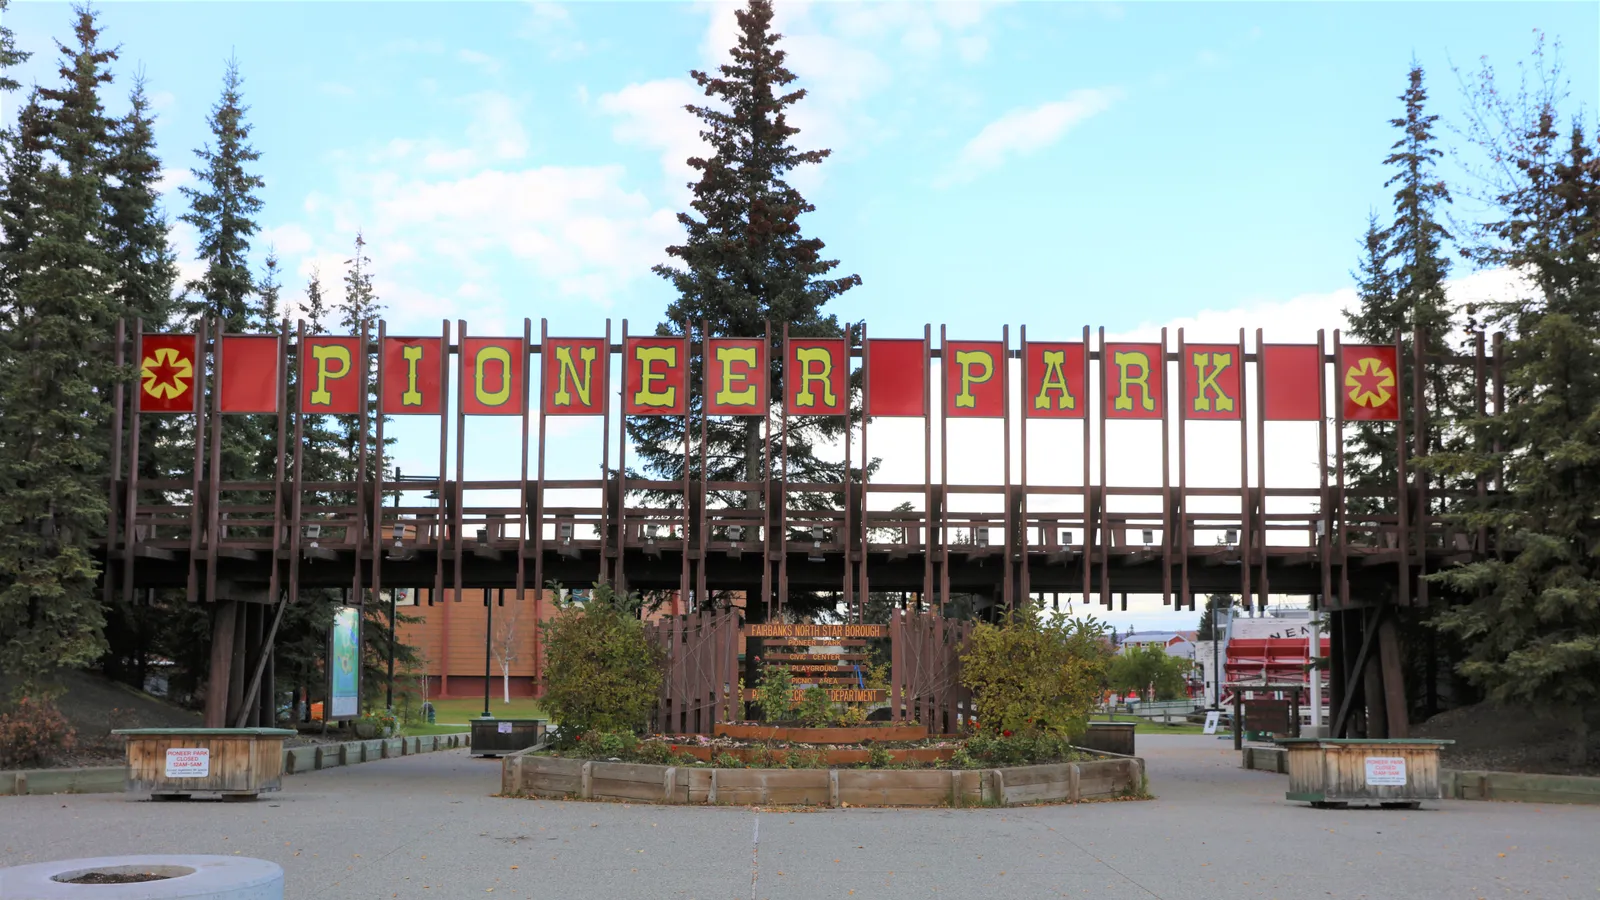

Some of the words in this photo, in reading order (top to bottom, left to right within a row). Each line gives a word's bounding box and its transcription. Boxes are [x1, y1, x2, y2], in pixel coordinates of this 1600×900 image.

[310, 344, 838, 408] PIONEER
[954, 350, 1235, 413] PARK
[751, 624, 793, 637] FAIRBANKS
[794, 624, 820, 637] NORTH
[822, 624, 843, 637] STAR
[845, 624, 880, 637] BOROUGH
[830, 689, 877, 702] DEPARTMENT
